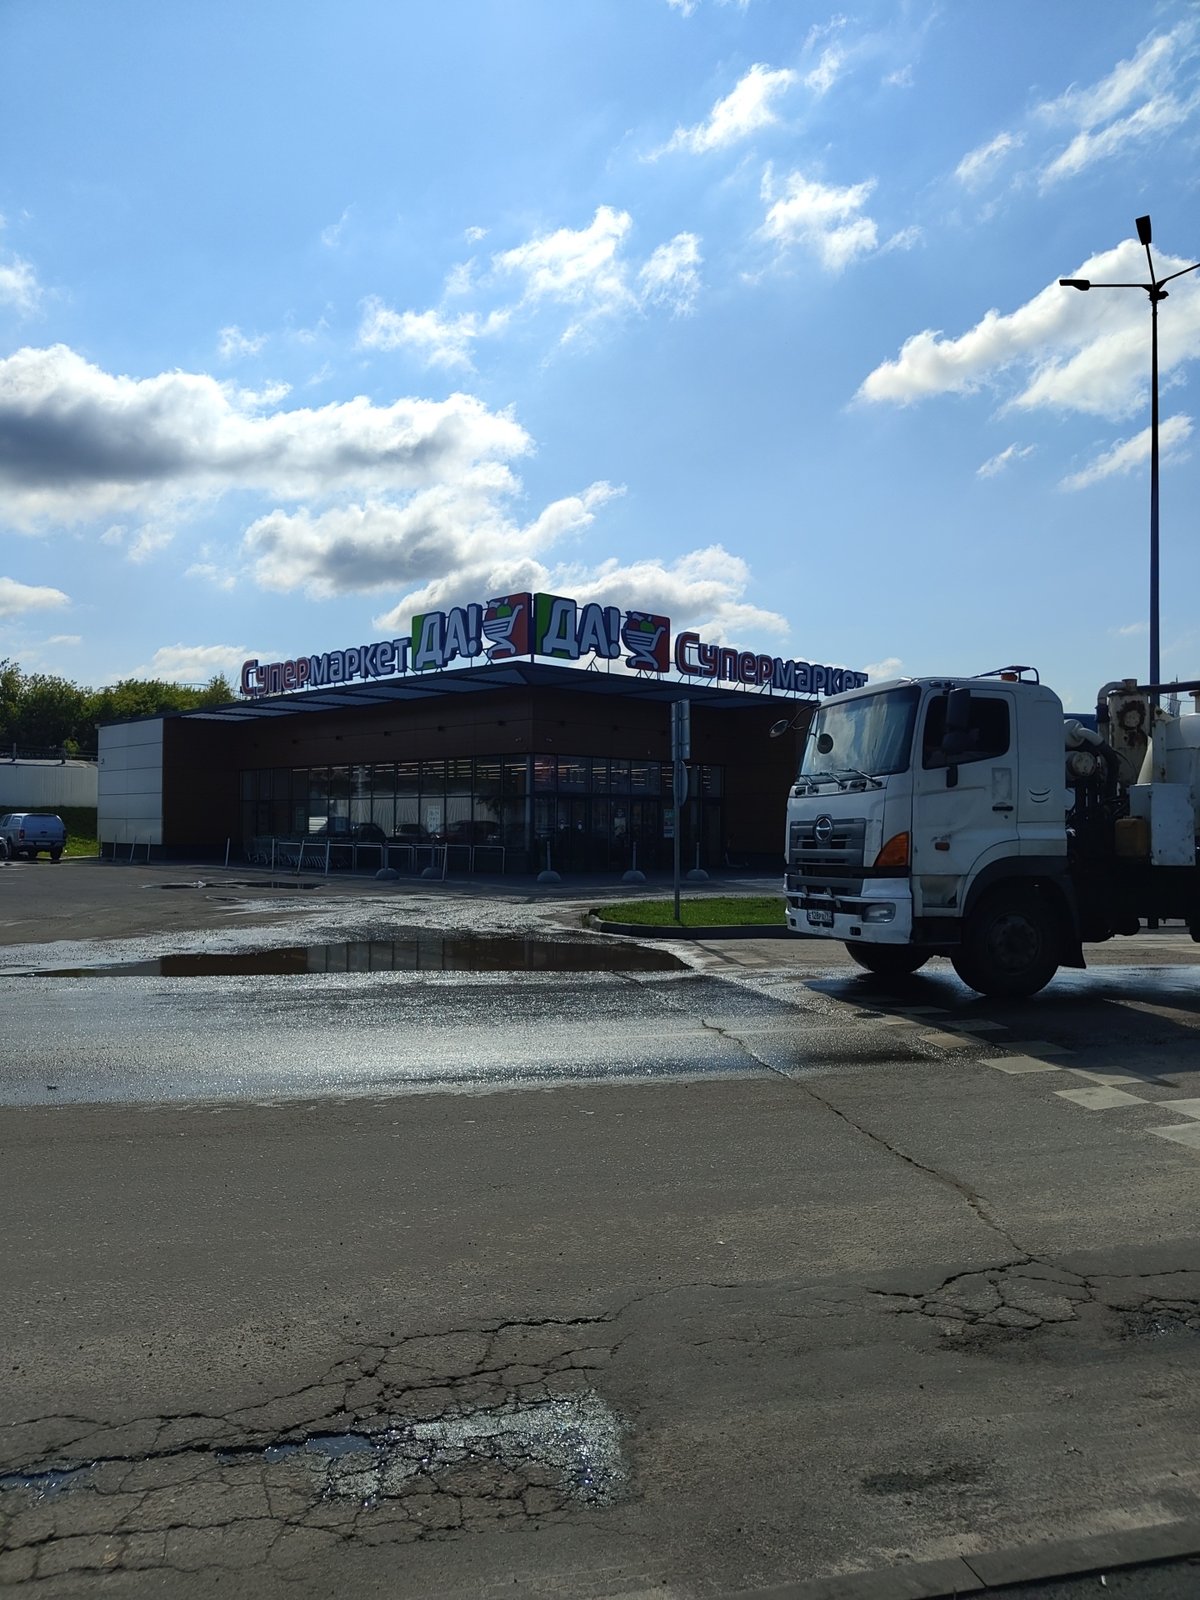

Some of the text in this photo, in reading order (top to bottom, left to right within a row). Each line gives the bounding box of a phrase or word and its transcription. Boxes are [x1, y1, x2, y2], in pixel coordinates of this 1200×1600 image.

[241, 603, 482, 695] Супермаркет ДА!
[542, 598, 621, 659] ДА!
